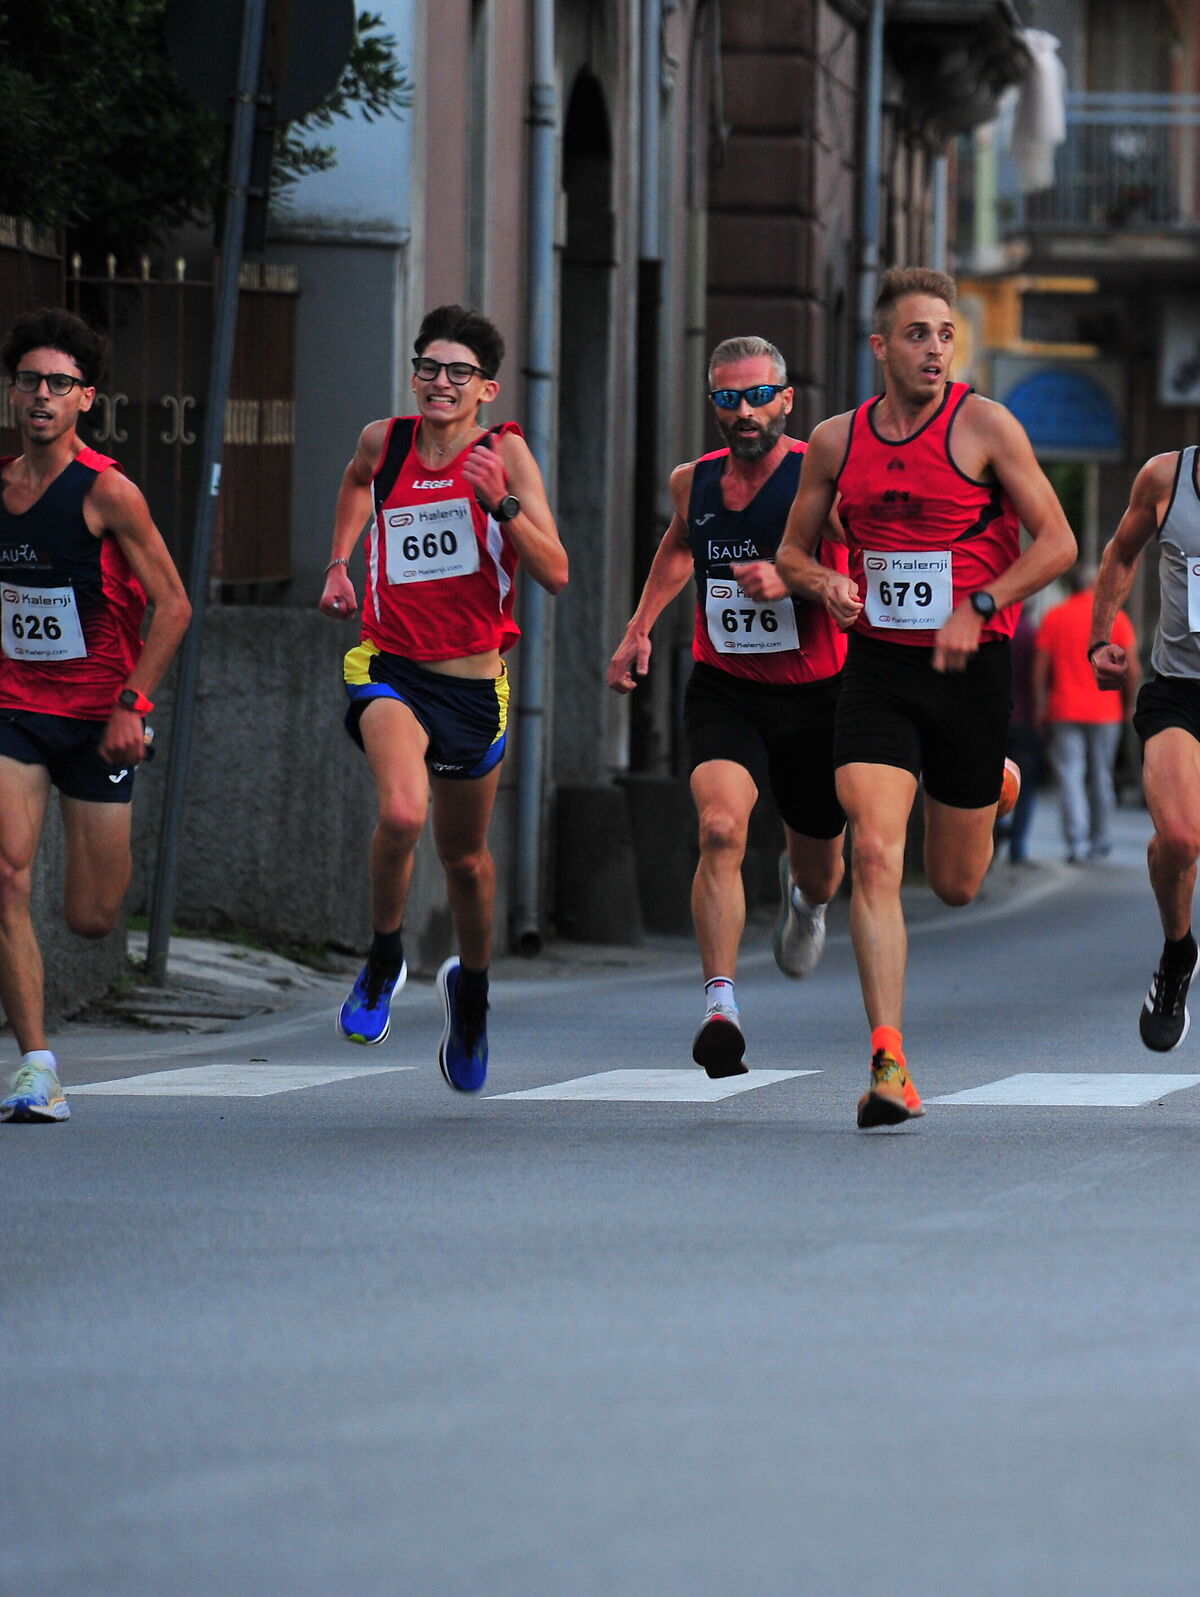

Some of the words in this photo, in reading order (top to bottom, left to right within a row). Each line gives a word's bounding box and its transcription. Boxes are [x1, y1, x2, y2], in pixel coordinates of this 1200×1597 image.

[420, 506, 467, 522] Kalenji
[0, 544, 38, 562] AURA
[403, 531, 457, 560] 660
[893, 559, 948, 573] Kalenji
[22, 593, 71, 607] Kalenji
[880, 581, 932, 607] 679
[12, 613, 62, 640] 626
[722, 609, 778, 632] 676
